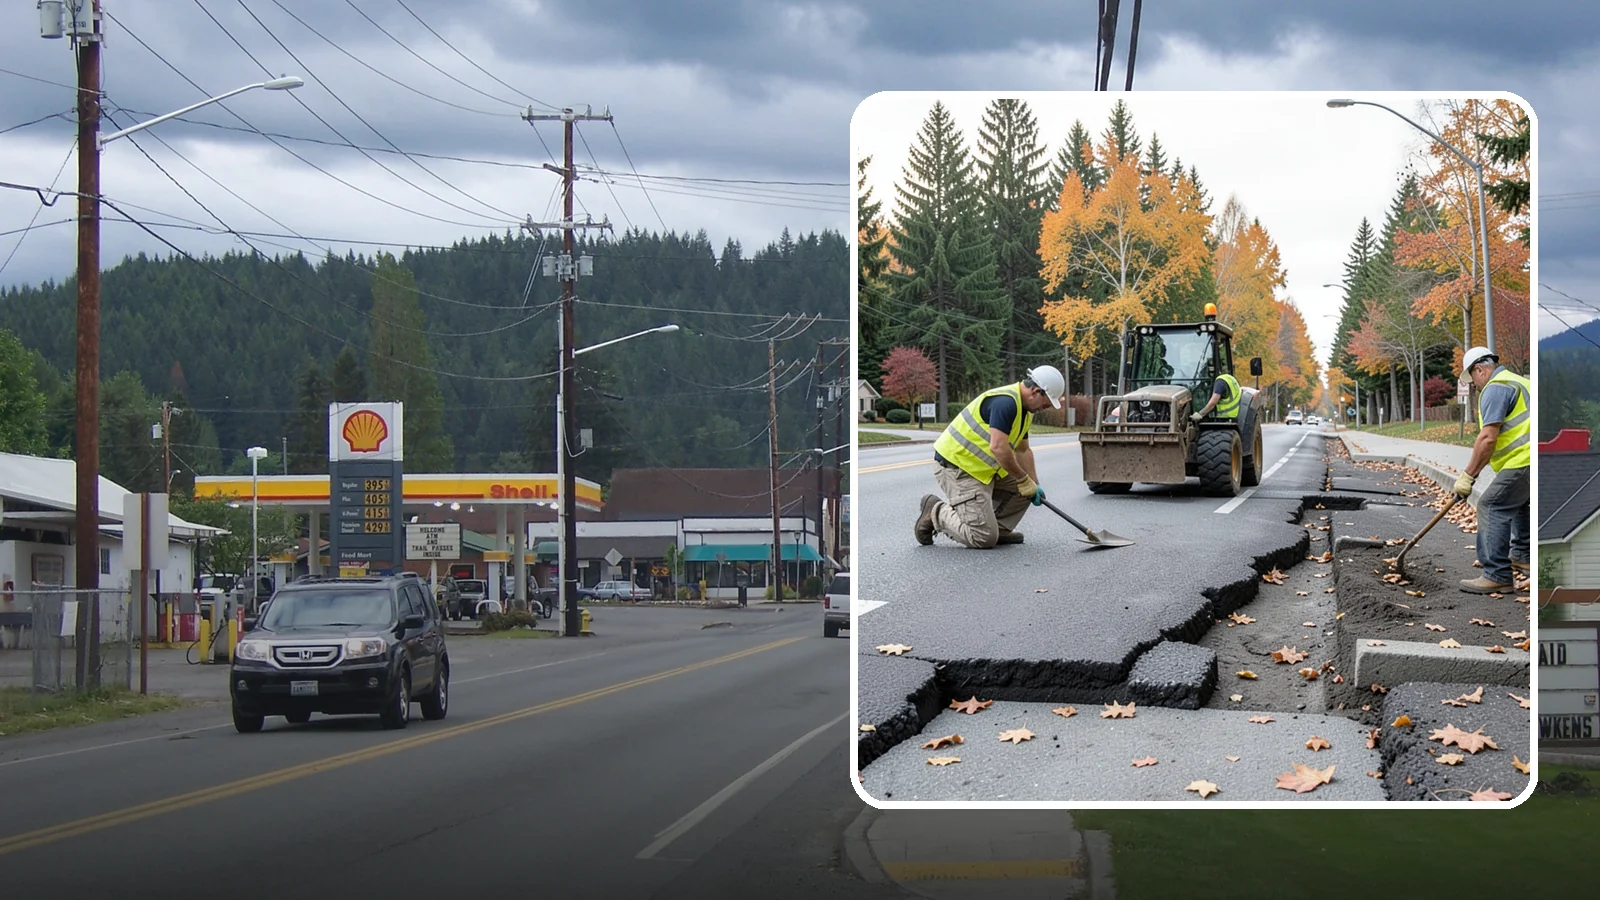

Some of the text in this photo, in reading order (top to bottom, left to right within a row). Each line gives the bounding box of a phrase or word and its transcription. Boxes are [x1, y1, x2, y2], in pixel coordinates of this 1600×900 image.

[366, 480, 383, 490] 395
[490, 484, 547, 499] Shell
[366, 494, 383, 504] 405
[366, 508, 383, 518] 415
[366, 522, 383, 532] 429
[1539, 643, 1567, 666] AID
[1539, 716, 1592, 739] WKENS
